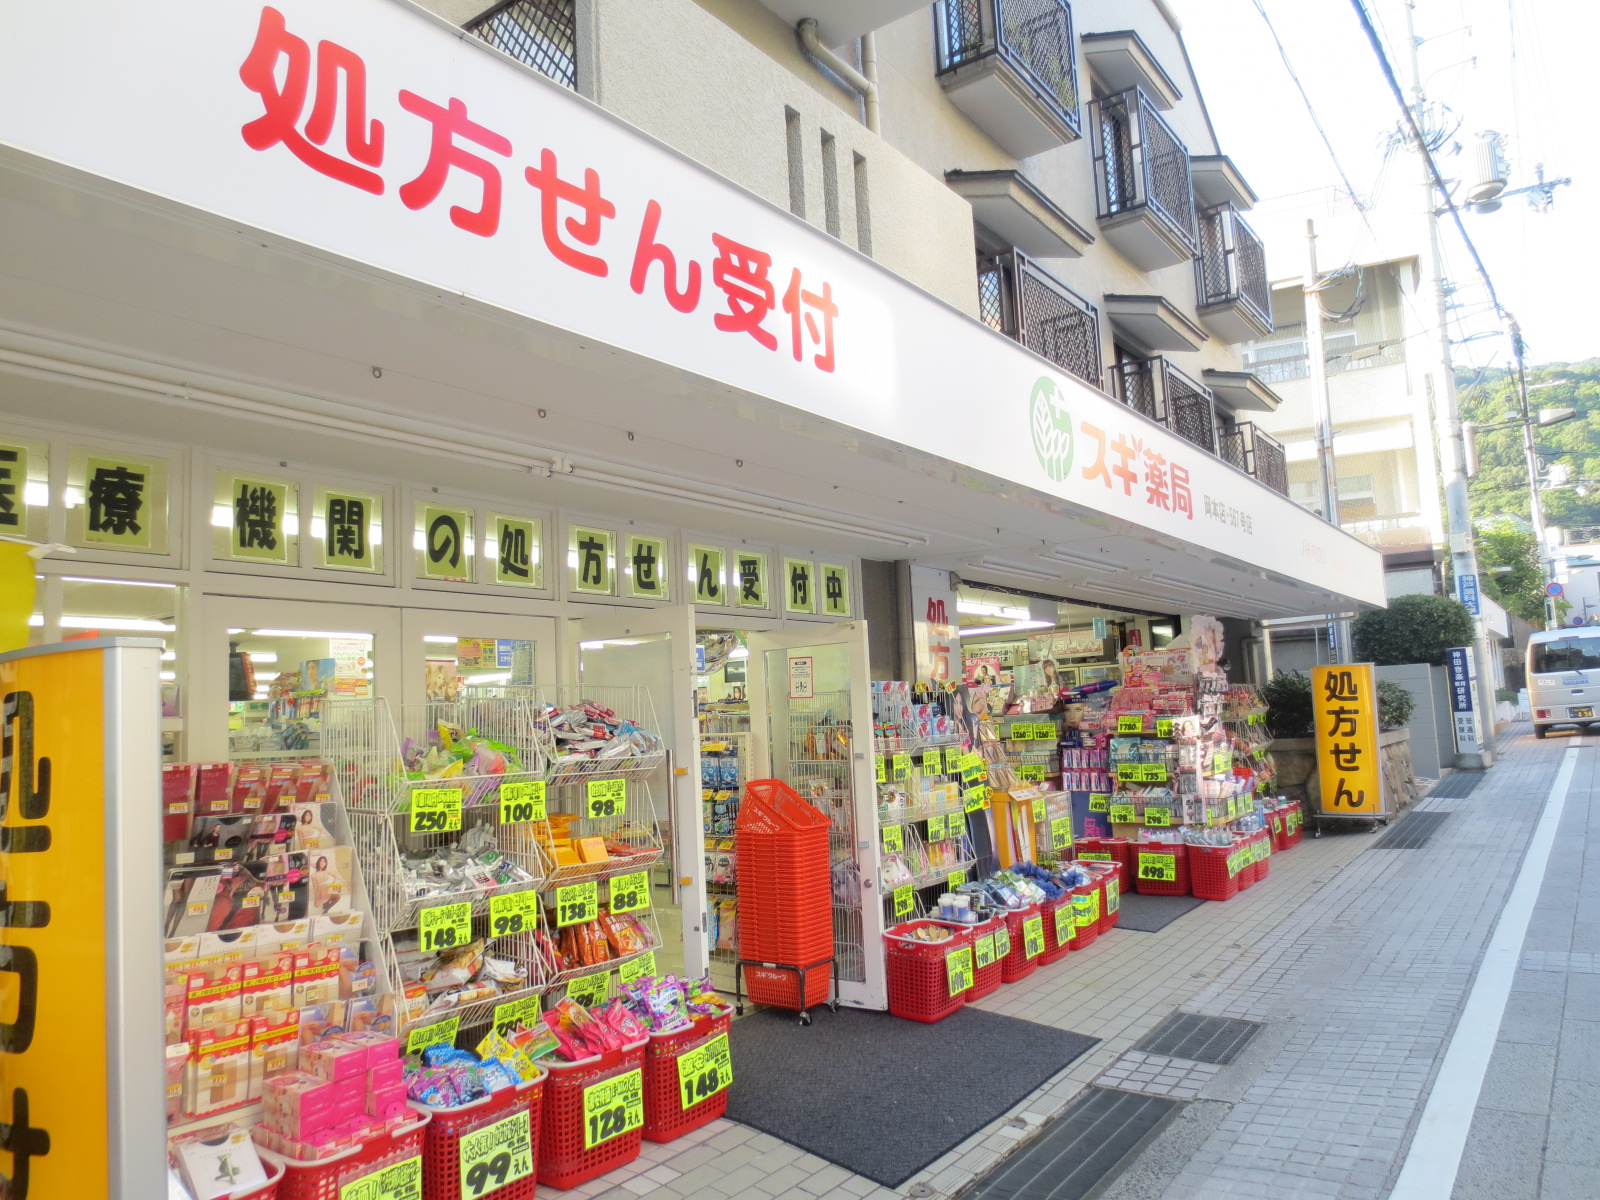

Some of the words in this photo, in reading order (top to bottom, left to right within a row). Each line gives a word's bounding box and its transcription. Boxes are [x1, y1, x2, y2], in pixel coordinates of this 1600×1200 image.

[240, 5, 838, 373] 処方せん受付
[1080, 421, 1193, 520] スギ薬局
[1323, 671, 1365, 808] 処方せん
[503, 802, 533, 822] 100
[591, 799, 615, 816] 98
[414, 811, 447, 831] 250
[1141, 865, 1165, 878] 498
[613, 890, 638, 911] 88
[560, 902, 587, 922] 138
[494, 913, 523, 935] 98
[423, 927, 457, 950] 148
[684, 1067, 719, 1106] 148
[589, 1105, 626, 1145] 128
[466, 1151, 512, 1195] 99
